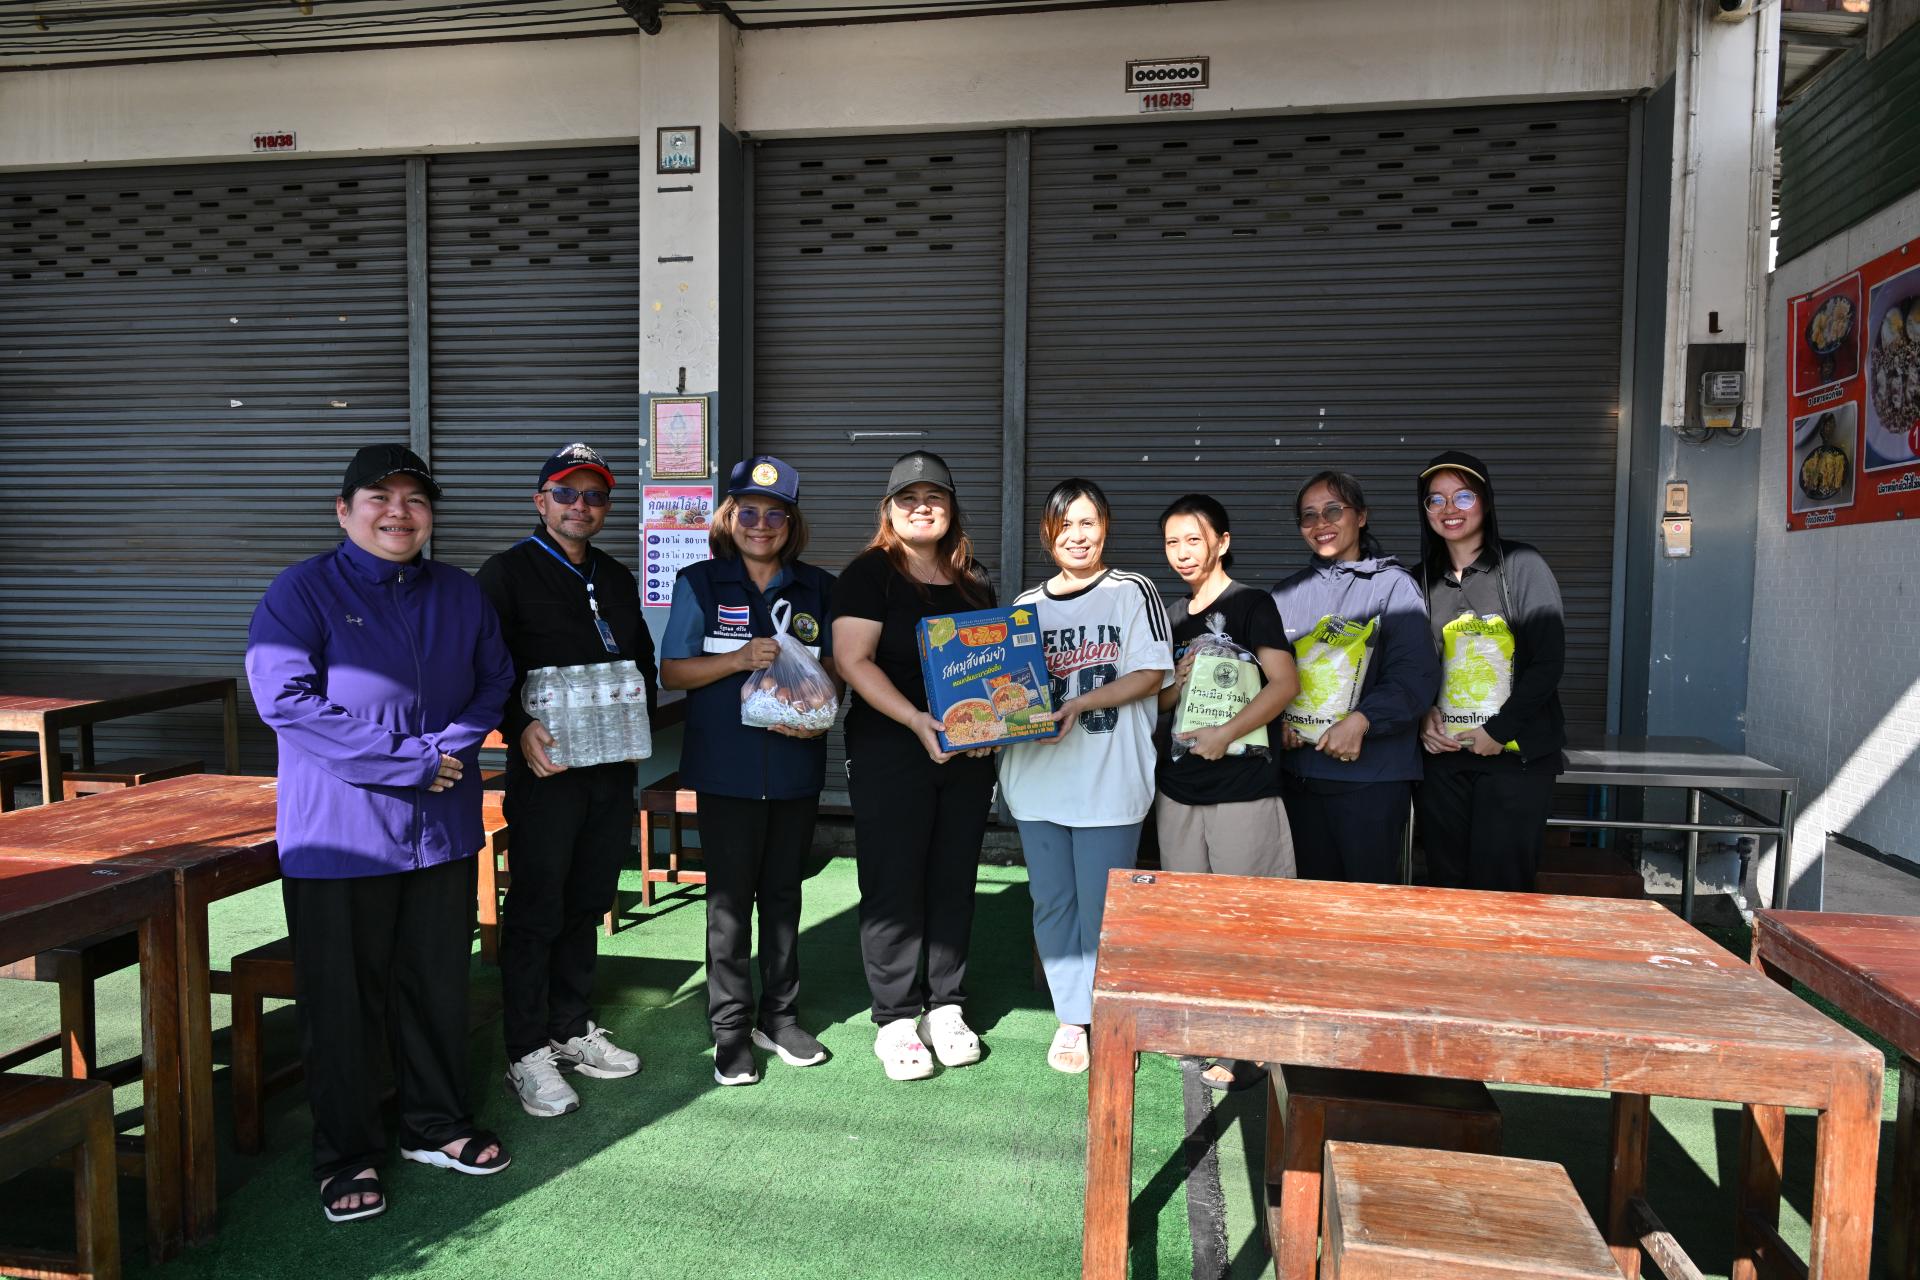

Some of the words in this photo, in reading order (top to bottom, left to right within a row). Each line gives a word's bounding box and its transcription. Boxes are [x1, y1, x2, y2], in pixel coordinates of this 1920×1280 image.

[1143, 92, 1191, 108] 118/39
[254, 134, 293, 149] 118/38
[682, 552, 695, 560] 120
[1043, 625, 1121, 653] ERLIN
[1044, 639, 1119, 672] reedom
[1190, 686, 1223, 700] ร่วมมือ
